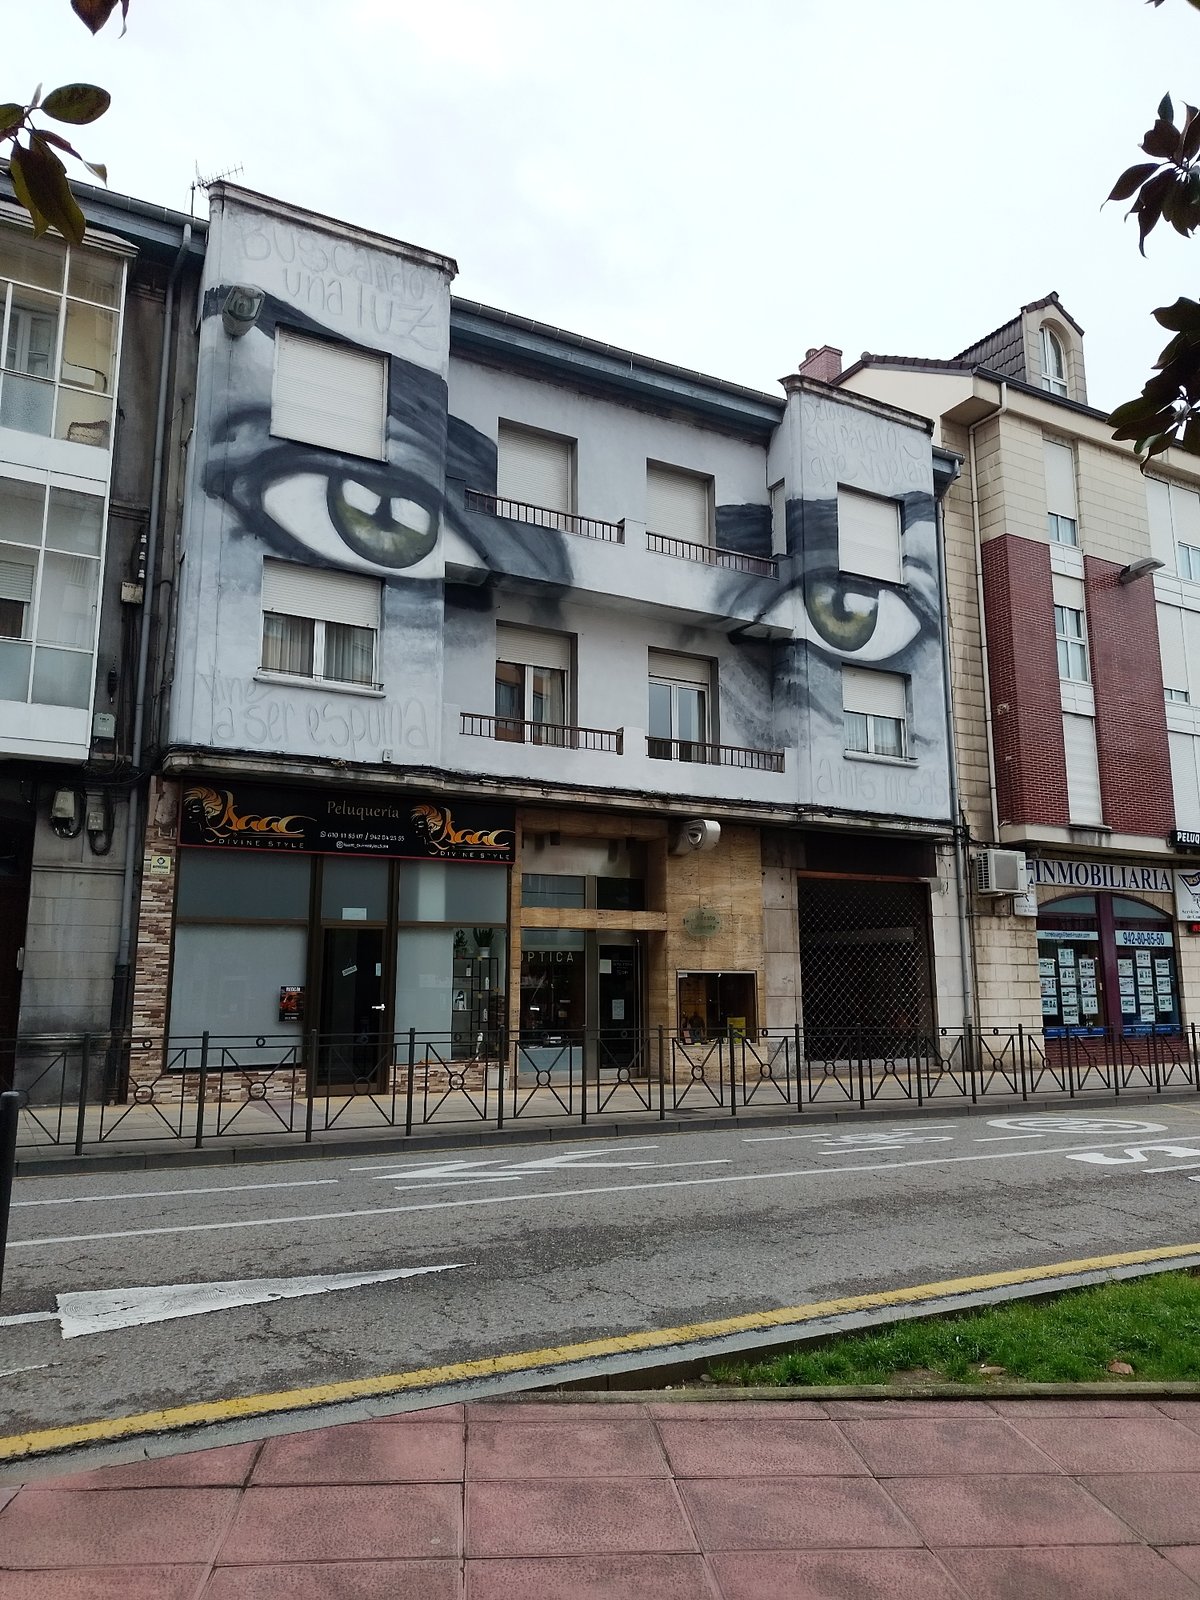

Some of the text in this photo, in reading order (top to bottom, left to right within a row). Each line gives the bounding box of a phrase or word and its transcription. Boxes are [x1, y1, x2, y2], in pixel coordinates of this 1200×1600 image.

[284, 268, 344, 316] una
[218, 838, 305, 849] DIVINE STYLE
[1035, 860, 1172, 891] INMOBILIARIA
[1122, 931, 1165, 946] 942-80-85-50
